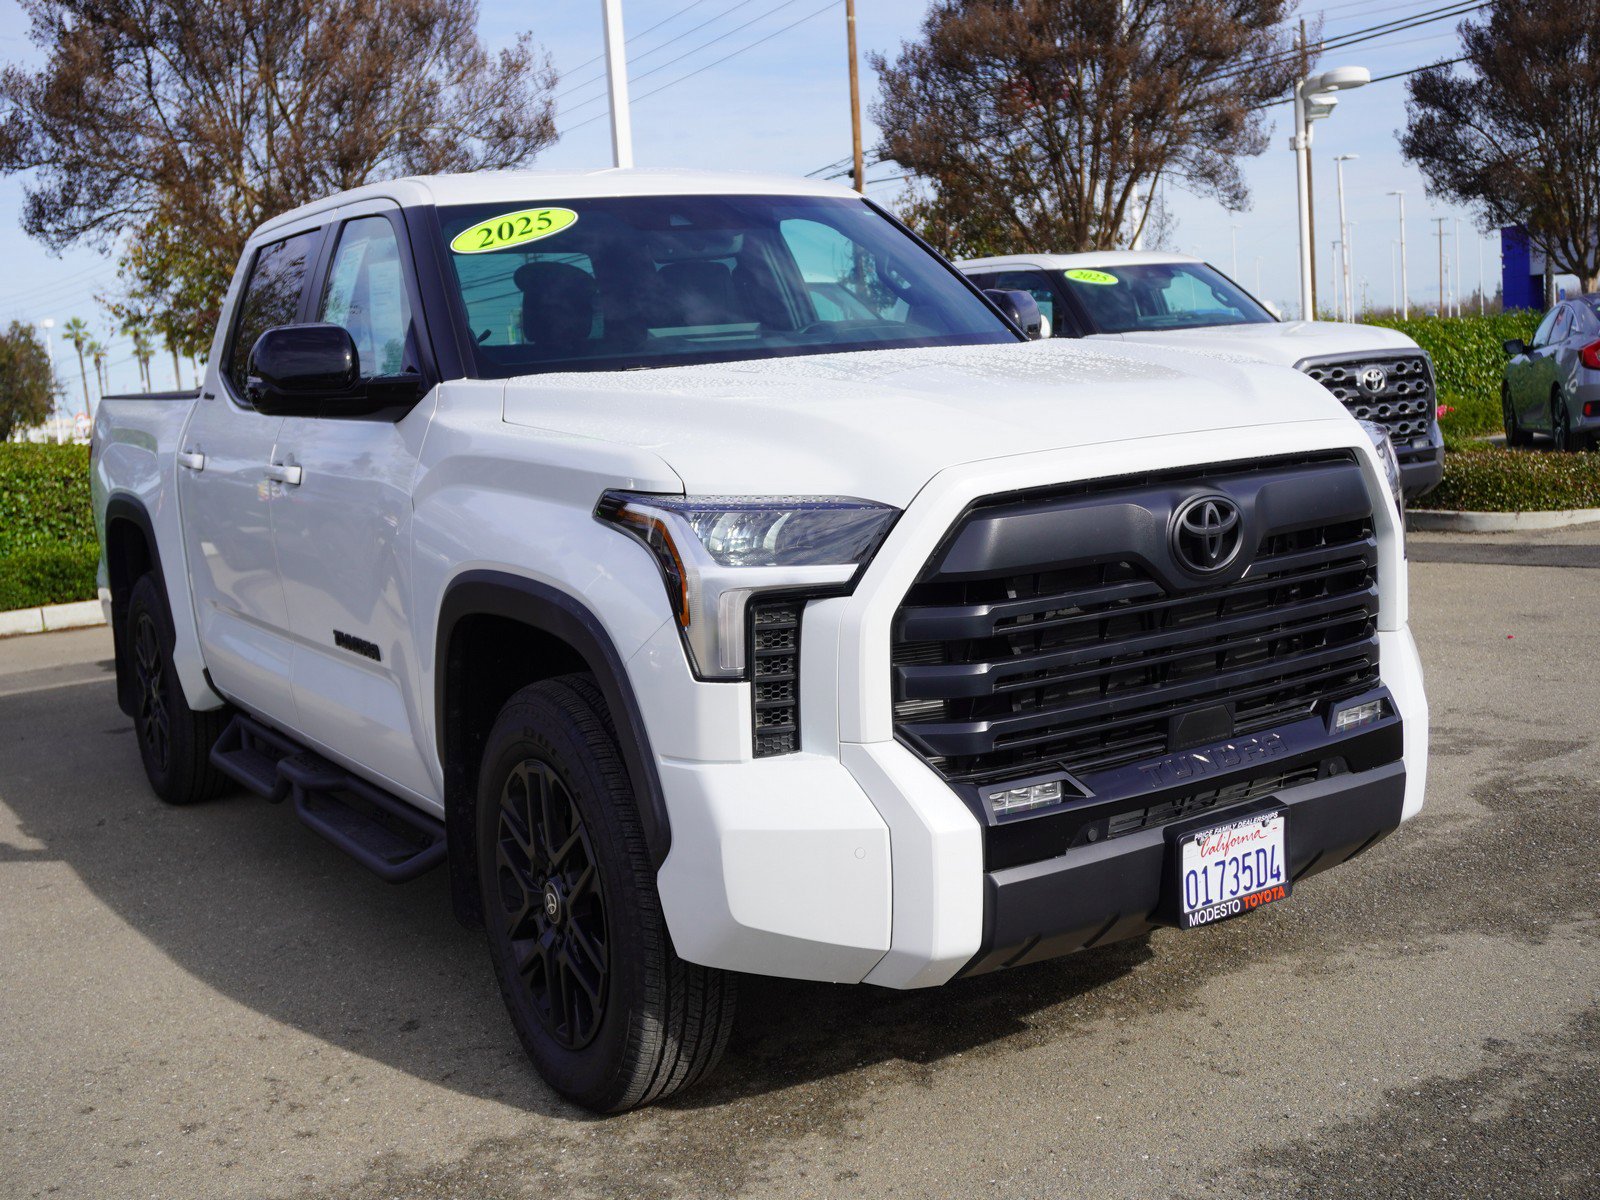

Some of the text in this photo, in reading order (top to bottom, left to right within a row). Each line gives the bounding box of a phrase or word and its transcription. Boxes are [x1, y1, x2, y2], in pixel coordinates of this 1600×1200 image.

[476, 211, 552, 248] 2025
[1074, 271, 1108, 281] 2025
[1138, 733, 1288, 787] TUNDRA
[1215, 823, 1237, 836] FAMILY
[1238, 811, 1278, 829] DEALERSHIPS
[1200, 829, 1267, 858] California
[1185, 844, 1281, 909] 01735D4
[1189, 886, 1285, 927] MODESTO TOYOTA
